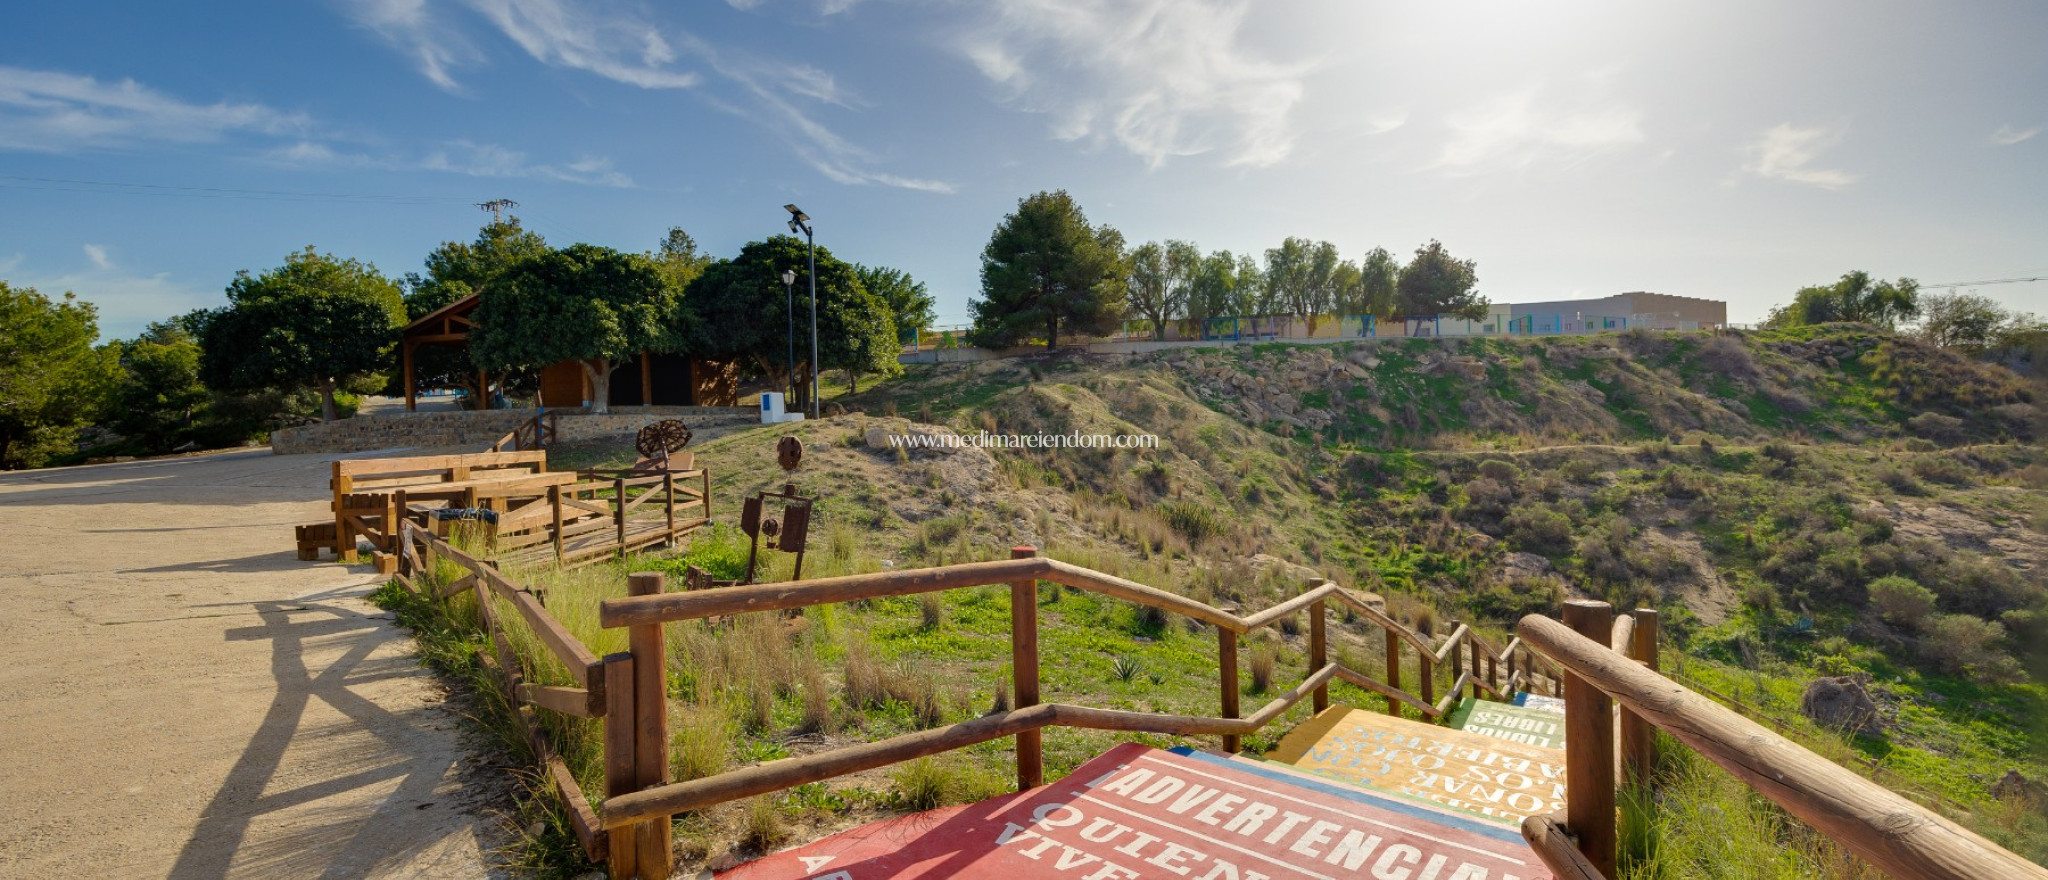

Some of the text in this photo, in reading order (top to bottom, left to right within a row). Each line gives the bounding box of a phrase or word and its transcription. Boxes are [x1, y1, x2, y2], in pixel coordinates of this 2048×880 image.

[1473, 711, 1557, 735] LIBRES
[1347, 726, 1566, 778] ABIERTOS
[1084, 764, 1520, 880] ¡ADVERTENCI
